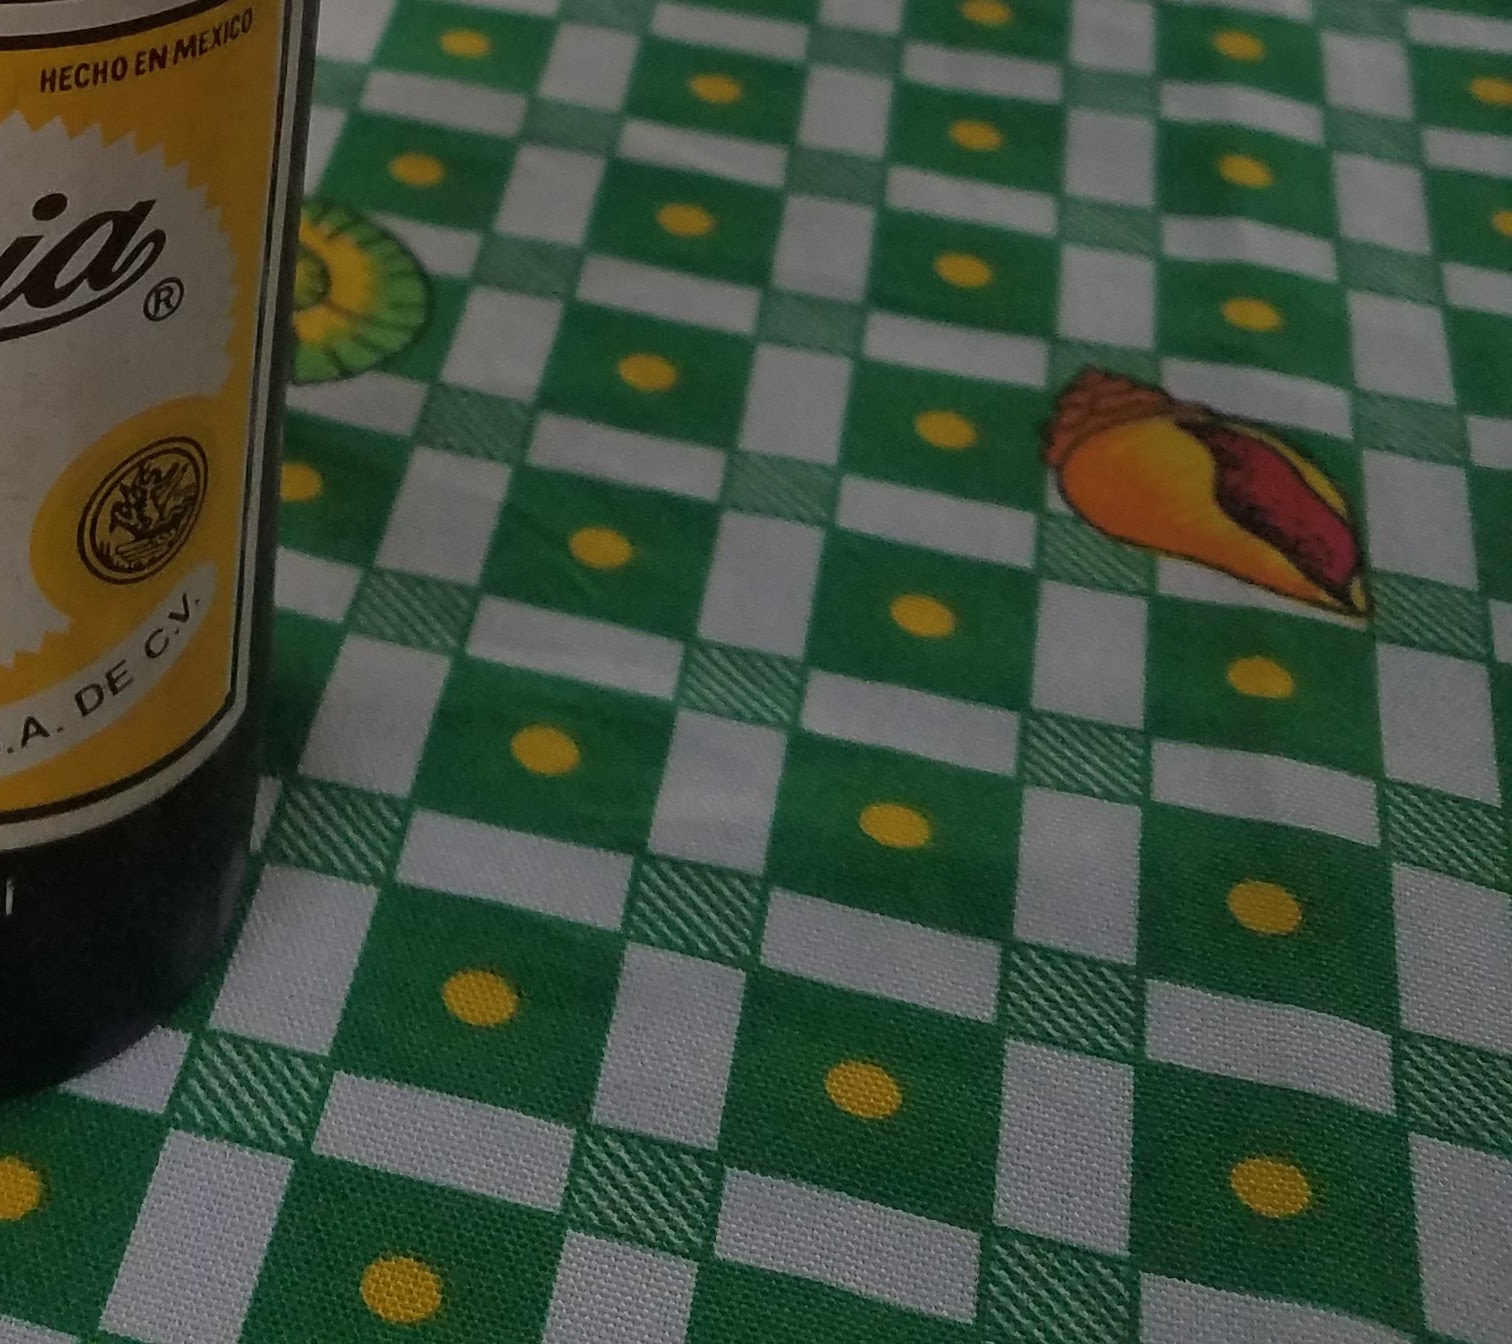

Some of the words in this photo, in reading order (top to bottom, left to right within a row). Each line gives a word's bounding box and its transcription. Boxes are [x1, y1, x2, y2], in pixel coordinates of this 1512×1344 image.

[39, 55, 129, 94] HECHO
[134, 44, 169, 77] EN
[172, 7, 254, 66] MEXICO
[73, 659, 135, 718] DE
[143, 592, 201, 660] C.V.
